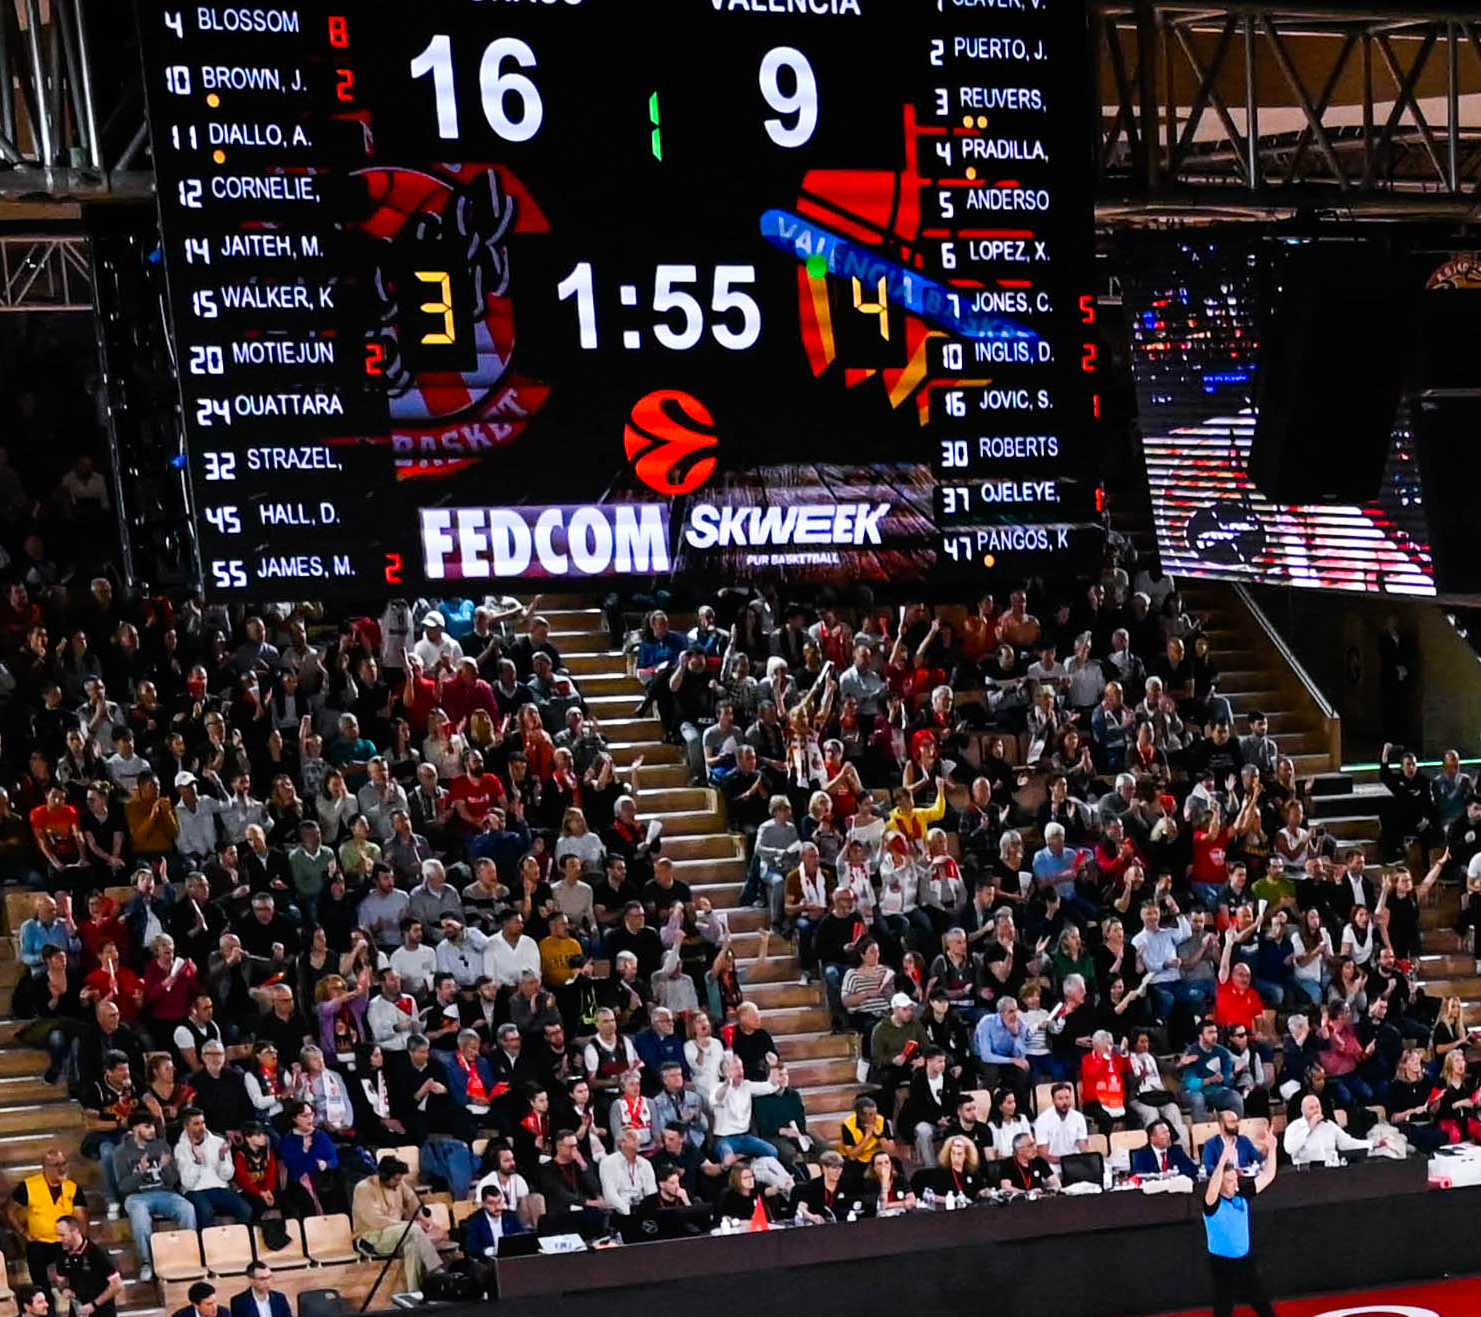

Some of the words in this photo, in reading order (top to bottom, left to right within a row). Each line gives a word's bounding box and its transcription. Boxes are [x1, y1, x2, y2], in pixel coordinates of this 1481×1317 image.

[164, 11, 183, 38] 4
[197, 7, 300, 32] BLOSSOM
[328, 16, 349, 47] 8
[930, 39, 944, 66] 2
[954, 37, 1030, 62] PUERTO,
[1034, 40, 1048, 60] J.
[166, 66, 191, 95] 10
[202, 66, 286, 93] BROWN,
[291, 69, 307, 91] J.
[335, 69, 354, 101] 2
[410, 34, 544, 142] 16
[758, 45, 818, 148] 9
[935, 88, 948, 115] 3
[960, 87, 1047, 113] REUVERS,
[172, 125, 198, 150] 11
[208, 122, 288, 149] DIALLO,
[293, 125, 312, 146] A.
[649, 90, 662, 162] 1
[936, 142, 952, 167] 4
[962, 138, 1049, 163] PRADILLA,
[179, 179, 203, 208] 12
[211, 177, 320, 203] CORNELIE,
[939, 191, 954, 219] 5
[966, 189, 1050, 210] ANDERSO
[184, 238, 210, 264] 14
[221, 235, 297, 260] JAITEH,
[301, 235, 323, 257] M.
[941, 242, 957, 269] 6
[970, 241, 1030, 263] LOPEZ,
[1034, 241, 1050, 261] X.
[193, 290, 218, 318] 15
[221, 286, 314, 311] WALKER,
[319, 287, 334, 308] K
[414, 271, 455, 344] 3
[557, 261, 762, 351] 1:55
[852, 275, 890, 341] 4
[946, 293, 960, 319] 7
[971, 292, 1032, 314] JONES,
[1036, 292, 1053, 312] C.
[1078, 295, 1095, 324] 5
[190, 346, 224, 375] 20
[232, 342, 334, 364] MOTIEJUN
[365, 343, 384, 375] 2
[942, 343, 963, 370] 10
[975, 342, 1034, 364] INGLIS,
[1038, 342, 1055, 362] D.
[1082, 343, 1097, 373] 2
[196, 398, 231, 426] 24
[235, 394, 343, 415] OUATTARA
[945, 391, 966, 417] 16
[979, 390, 1033, 411] JOVIC,
[1038, 390, 1053, 409] S.
[203, 452, 236, 480] 32
[247, 447, 342, 471] STRAZEL,
[941, 440, 968, 468] 30
[979, 436, 1059, 458] ROBERTS
[943, 487, 970, 513] 37
[981, 482, 1060, 503] OJELEYE,
[205, 506, 241, 533] 45
[259, 503, 316, 526] HALL,
[320, 503, 340, 524] D.
[685, 503, 890, 549] SKWEEK
[425, 505, 671, 580] FEDCOM
[944, 537, 972, 561] 47
[977, 531, 1052, 552] PANGOS,
[1057, 530, 1068, 549] K
[212, 560, 247, 588] 55
[257, 556, 329, 579] JAMES,
[334, 555, 356, 576] M.
[384, 553, 404, 584] 2
